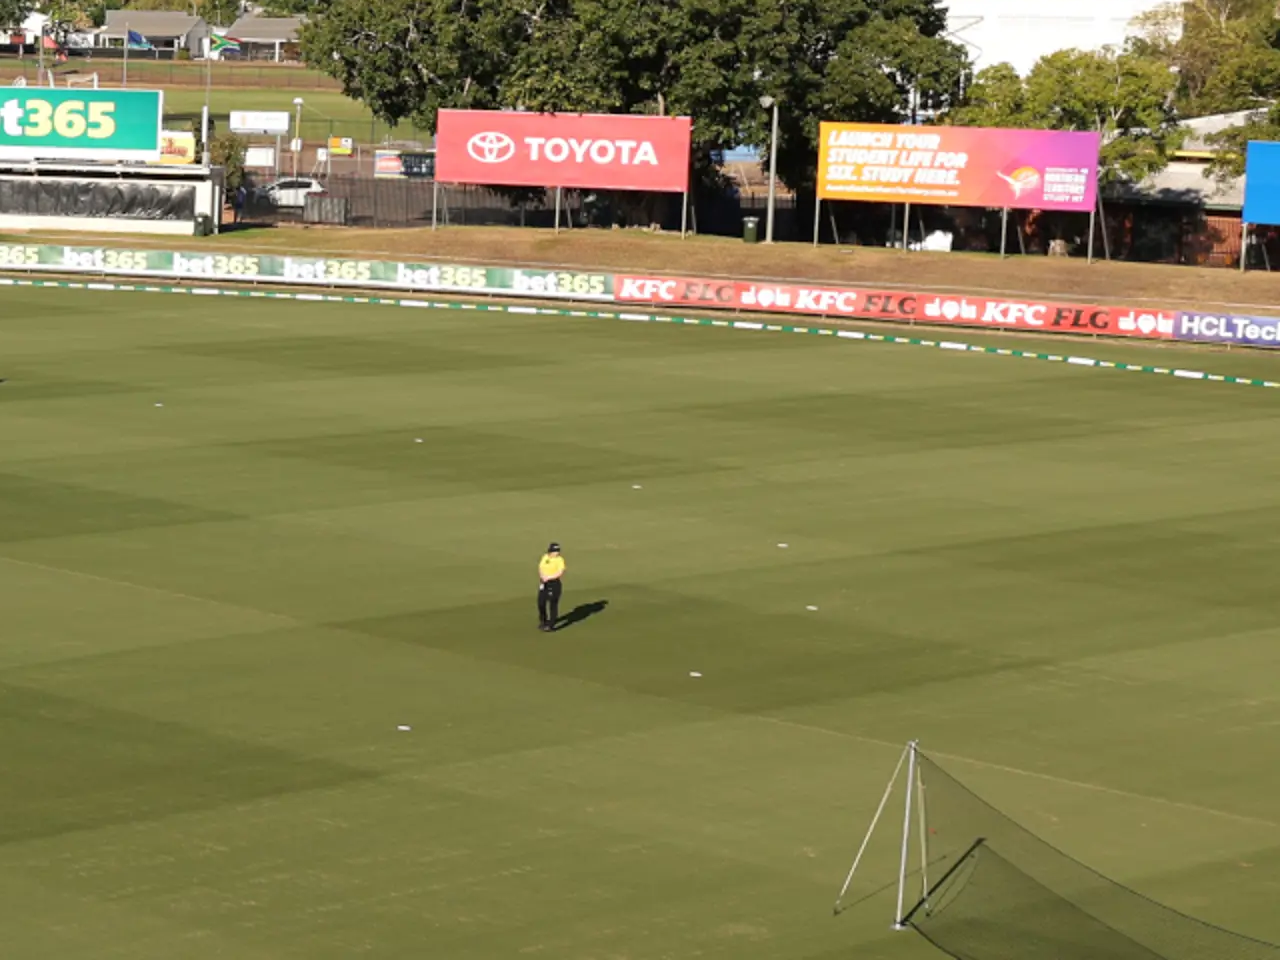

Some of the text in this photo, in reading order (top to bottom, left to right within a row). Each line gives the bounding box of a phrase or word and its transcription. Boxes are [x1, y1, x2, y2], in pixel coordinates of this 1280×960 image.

[524, 136, 659, 165] TOYOTA
[826, 148, 898, 165] STUDENT
[861, 166, 913, 183] STUDY
[63, 246, 147, 270] bet365
[172, 252, 259, 276] bet365
[283, 257, 371, 281] bet365
[396, 262, 487, 287] bet365
[512, 270, 605, 294] bet365
[619, 278, 734, 302] KFC FLG
[794, 289, 918, 315] KFC FLG
[981, 301, 1110, 329] KFC FLG
